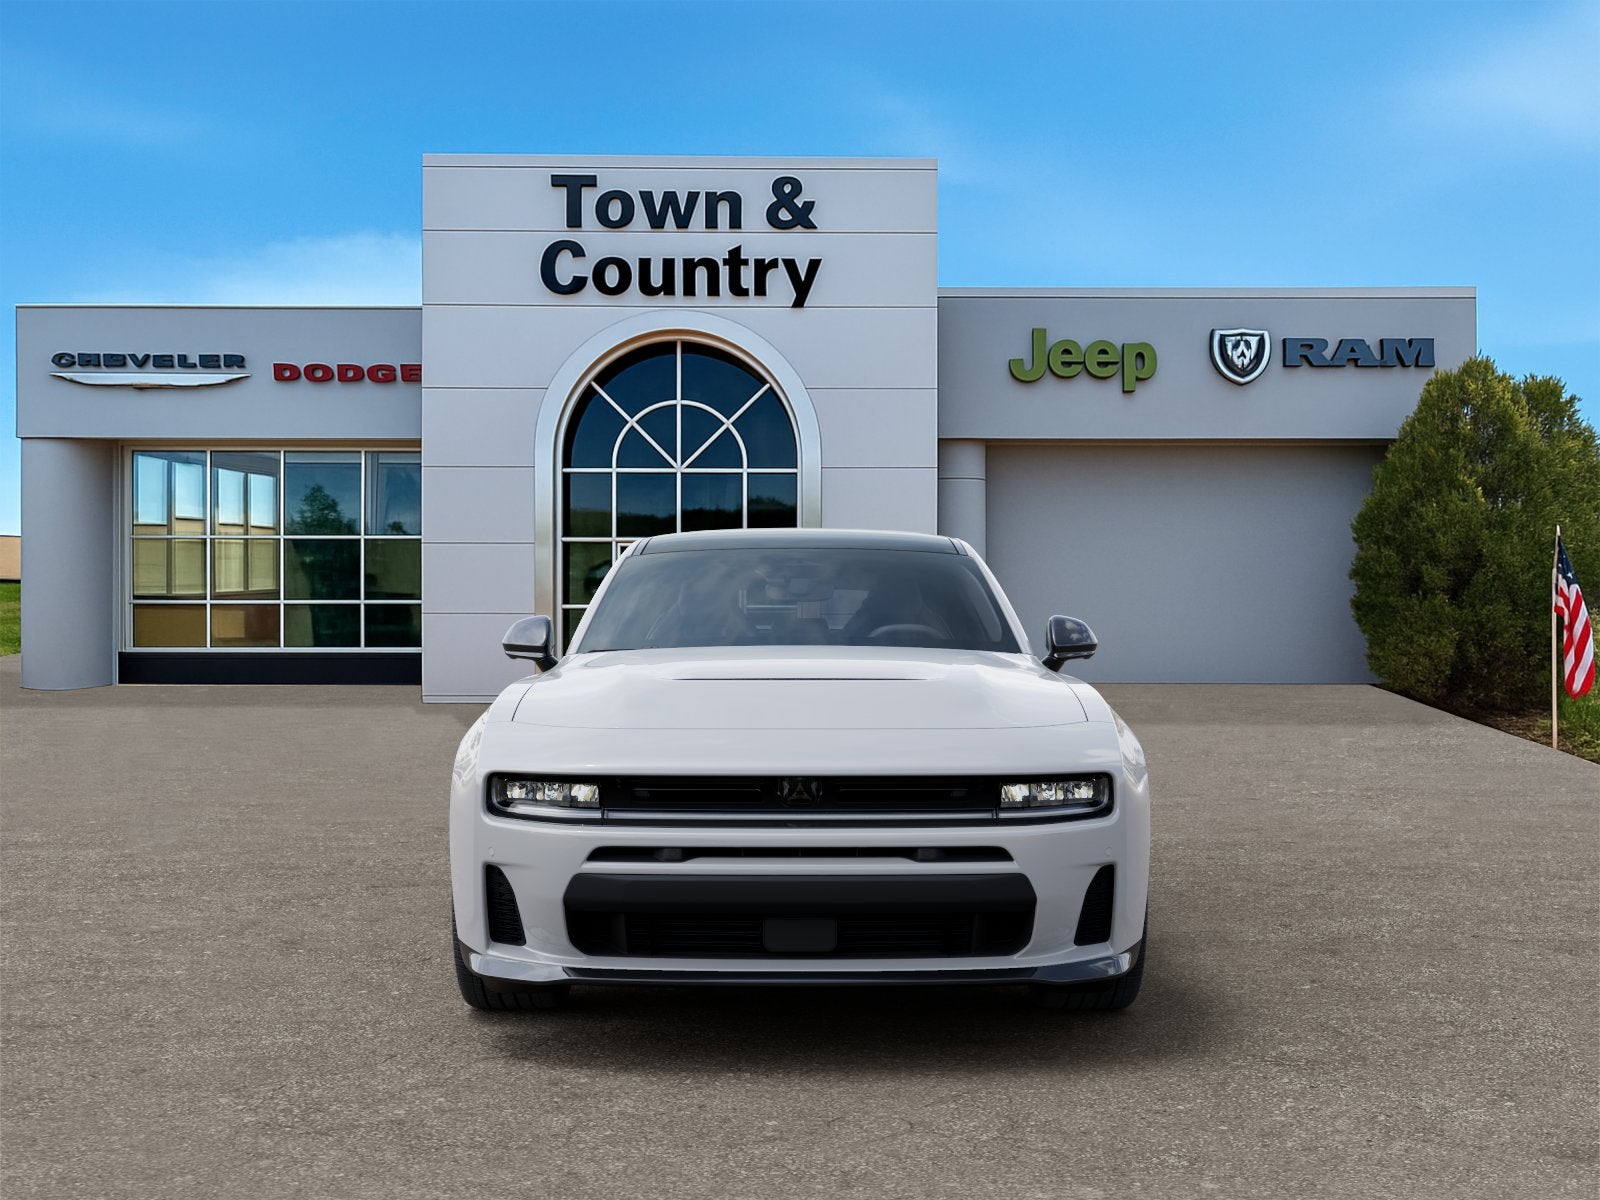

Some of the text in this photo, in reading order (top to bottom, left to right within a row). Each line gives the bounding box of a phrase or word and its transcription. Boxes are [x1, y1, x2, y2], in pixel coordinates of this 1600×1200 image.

[551, 174, 817, 229] Town &
[541, 240, 822, 308] Country
[273, 362, 422, 383] DODGE
[1009, 327, 1157, 392] Jeep
[1282, 337, 1436, 368] RAM
